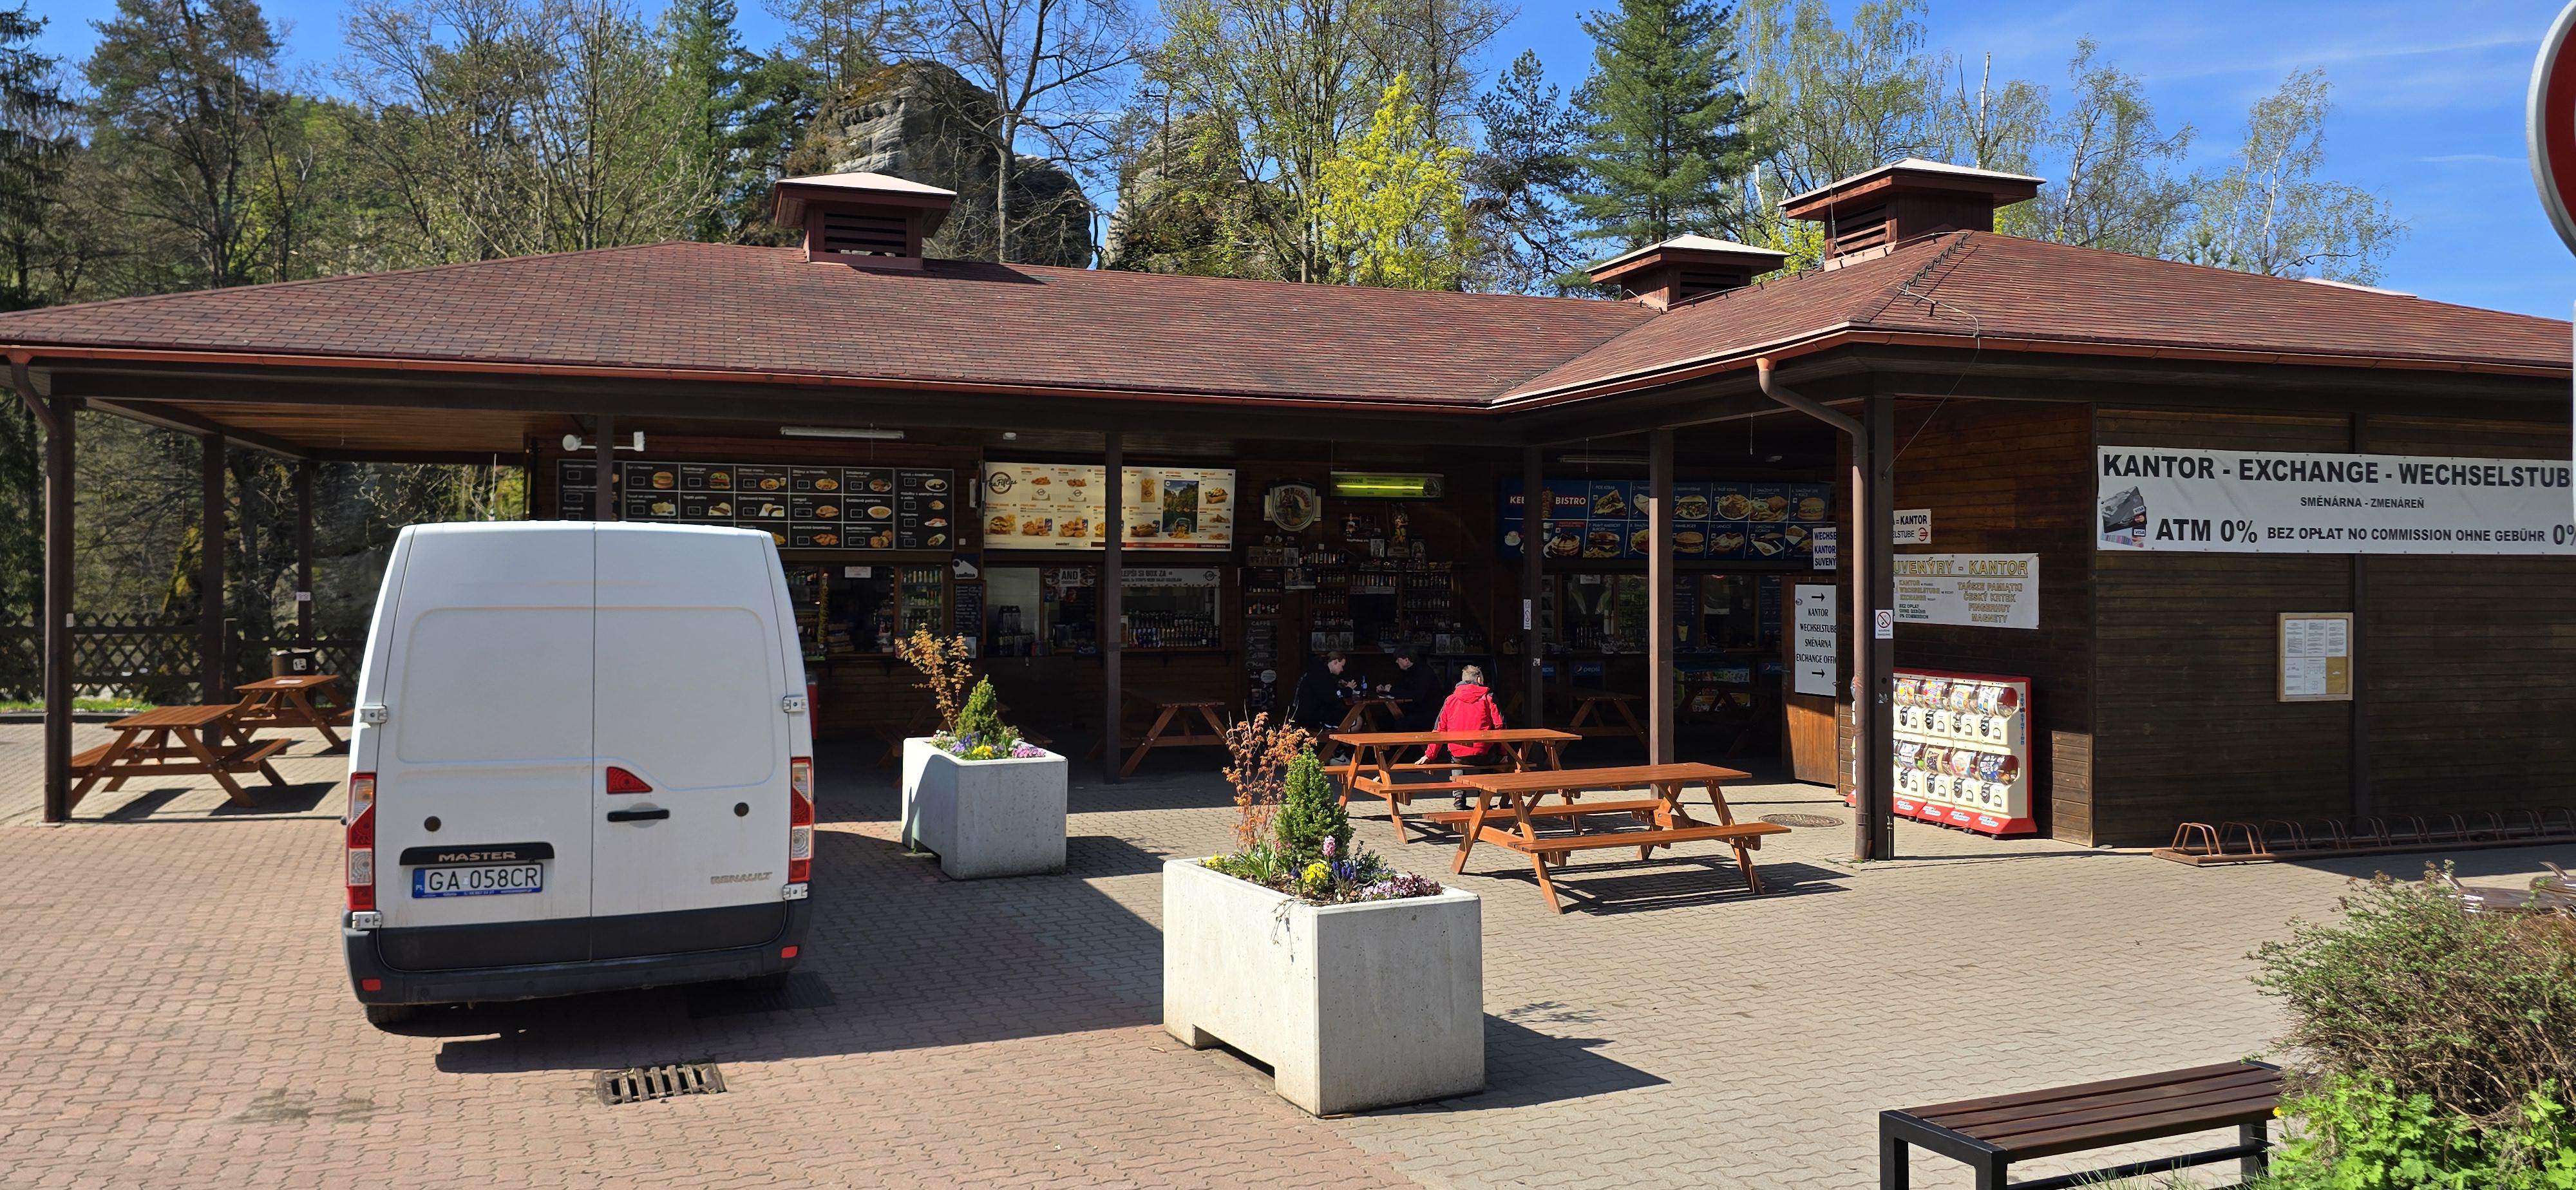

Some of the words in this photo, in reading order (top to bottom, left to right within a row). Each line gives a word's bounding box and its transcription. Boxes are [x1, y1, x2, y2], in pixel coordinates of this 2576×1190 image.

[2103, 454, 2215, 480] KANTOR
[2239, 458, 2378, 484] EXCHANGE
[2398, 463, 2573, 487] WECHSELSTUB
[1555, 496, 1586, 505] BISTRO
[2300, 495, 2362, 508] SMĚNÁRNA
[2371, 496, 2425, 509] ZMENÁREŇ
[1900, 515, 1927, 525] KANTOR
[2155, 518, 2211, 542] ATM
[2220, 519, 2258, 544] 0%
[2267, 527, 2295, 540] BEZ
[2298, 527, 2344, 541] OPŁAT
[2348, 528, 2367, 541] NO
[2371, 528, 2452, 542] COMMISSION
[2456, 529, 2491, 542] OHNE
[2494, 527, 2546, 543] GEBÜHR
[1815, 545, 1836, 554] KANTOR
[1969, 560, 2029, 575] KANTOR
[1808, 609, 1829, 617] KANTOR
[1796, 653, 1823, 663] EXCHANGE
[439, 851, 516, 862] MASTER
[429, 871, 460, 891] GA
[470, 867, 538, 889] 058CR
[710, 871, 773, 885] RENAULT
